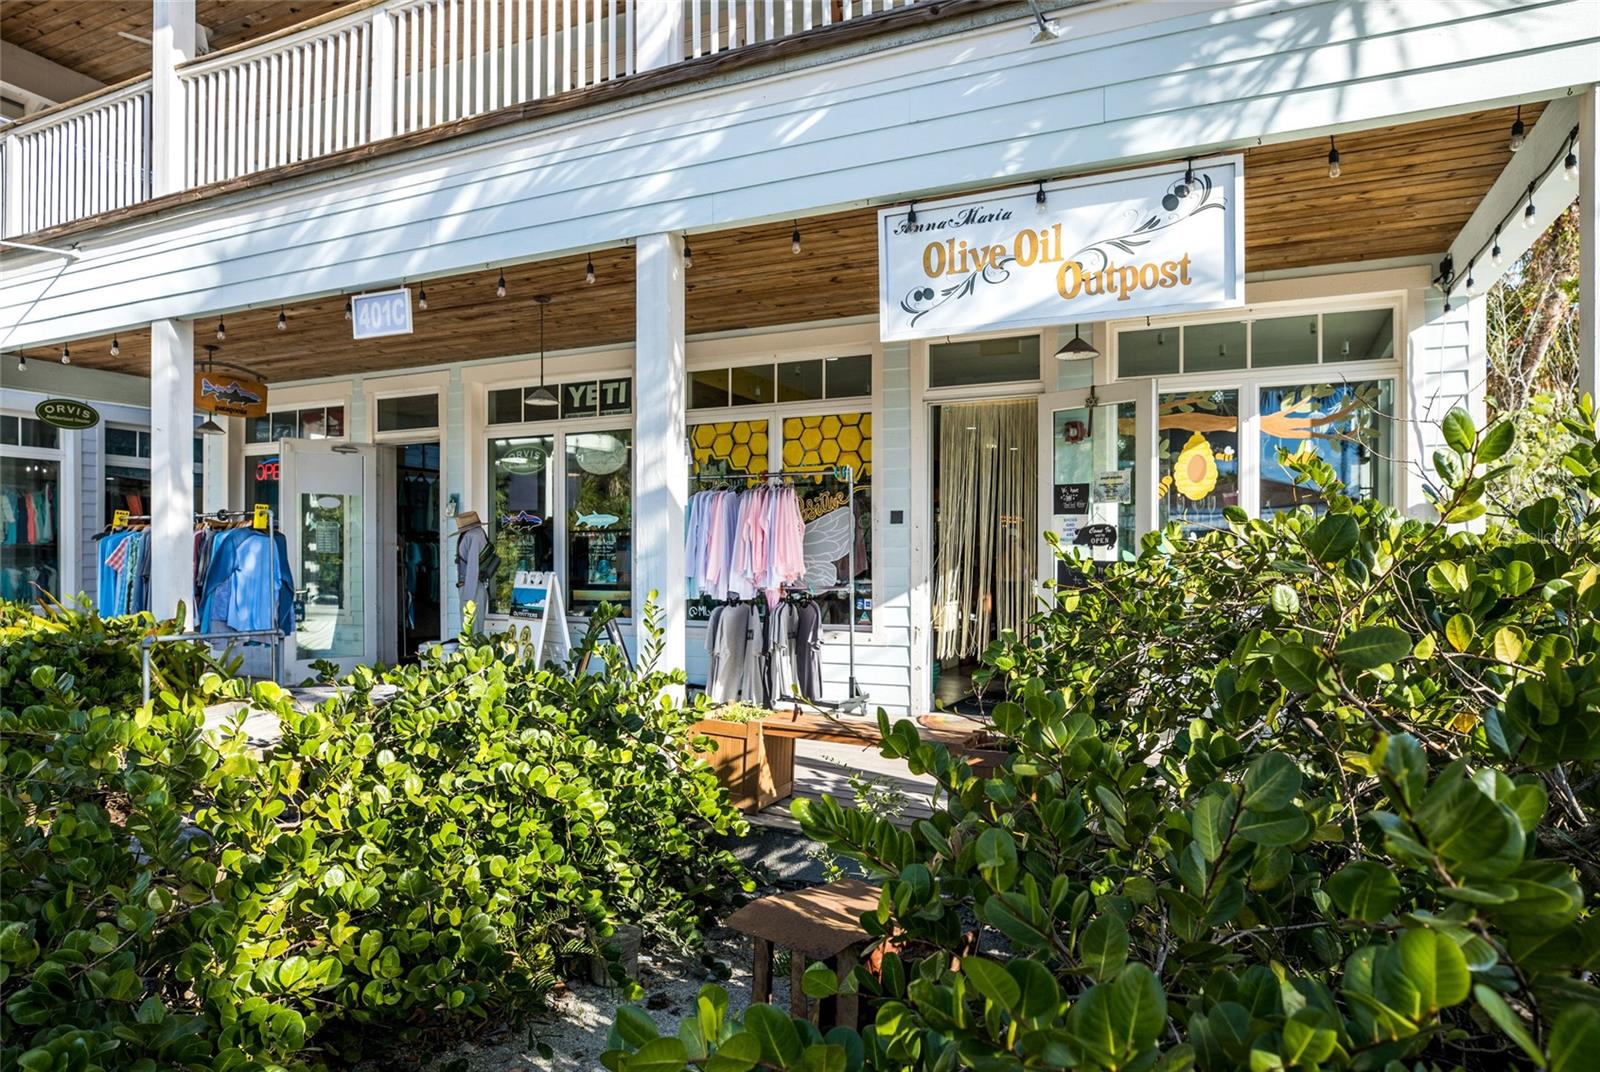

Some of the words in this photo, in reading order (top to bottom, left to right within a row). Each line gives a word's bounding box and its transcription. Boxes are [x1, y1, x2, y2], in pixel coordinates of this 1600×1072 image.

[893, 219, 946, 235] Anna
[948, 206, 1013, 229] Maria
[922, 236, 1007, 279] Olive
[1013, 222, 1064, 268] Oil
[1056, 252, 1192, 301] Outpost
[359, 298, 405, 330] 401C
[568, 381, 626, 408] YETI
[44, 404, 90, 419] ORVIS
[256, 463, 281, 481] OPE
[797, 490, 851, 521] ositive
[1090, 537, 1109, 545] OPEN
